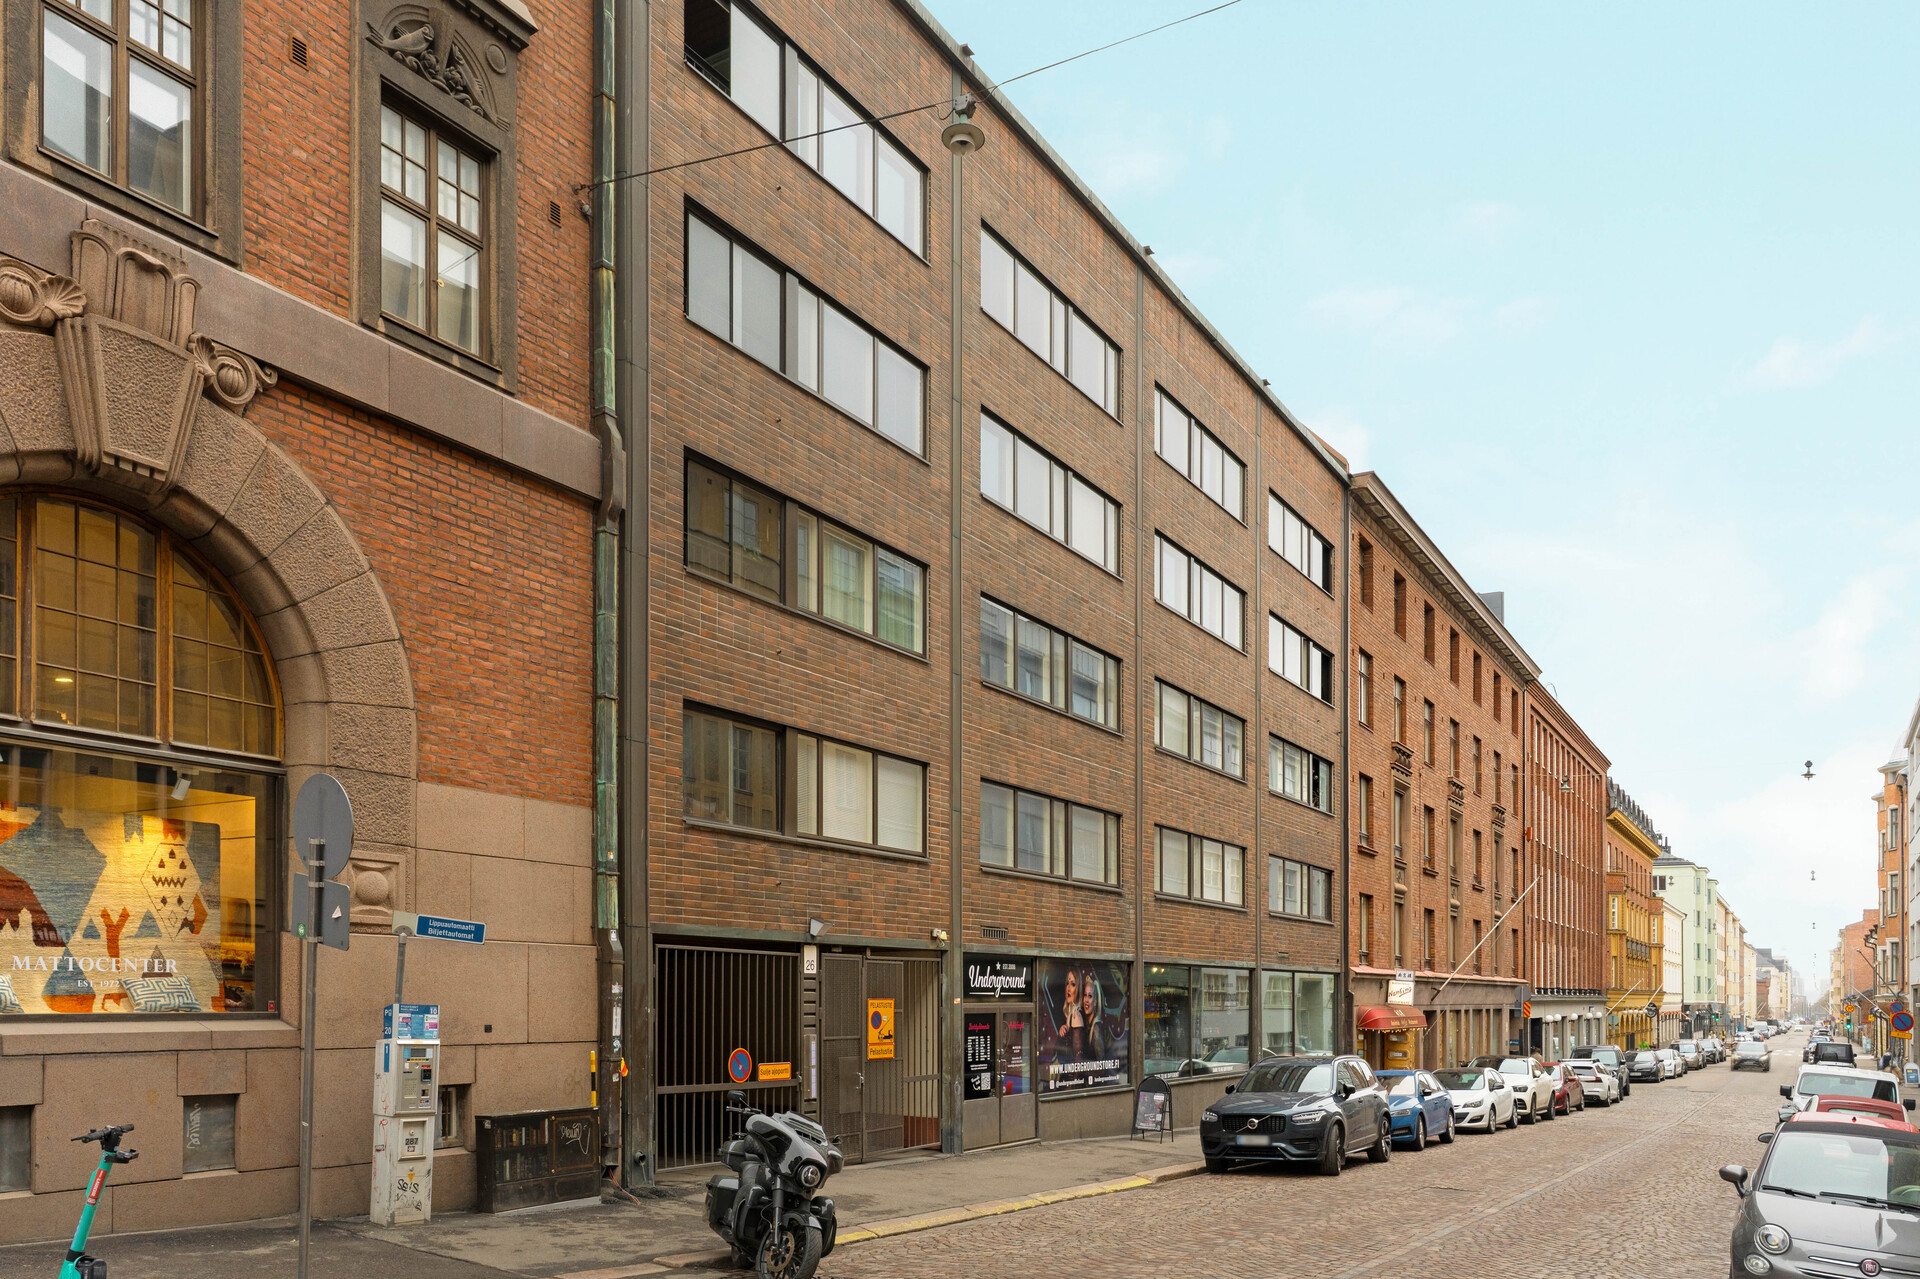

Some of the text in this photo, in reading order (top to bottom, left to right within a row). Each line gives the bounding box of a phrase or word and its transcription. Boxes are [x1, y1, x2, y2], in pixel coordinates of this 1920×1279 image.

[428, 919, 475, 931] Lippuautomaatti
[427, 928, 474, 940] Biljettautomat
[12, 955, 179, 973] MATTOCENTER
[806, 960, 815, 971] 26
[77, 979, 121, 988] EST. 1972
[968, 964, 1026, 998] Underground
[870, 1001, 893, 1009] PELASTUSTIE
[384, 1026, 392, 1035] 20
[870, 1047, 893, 1056] Pelastustie
[1049, 1059, 1120, 1074] WWW.UNDERGROUNDSTORE.FI
[405, 1137, 418, 1146] 287
[1865, 1263, 1876, 1272] FIAT
